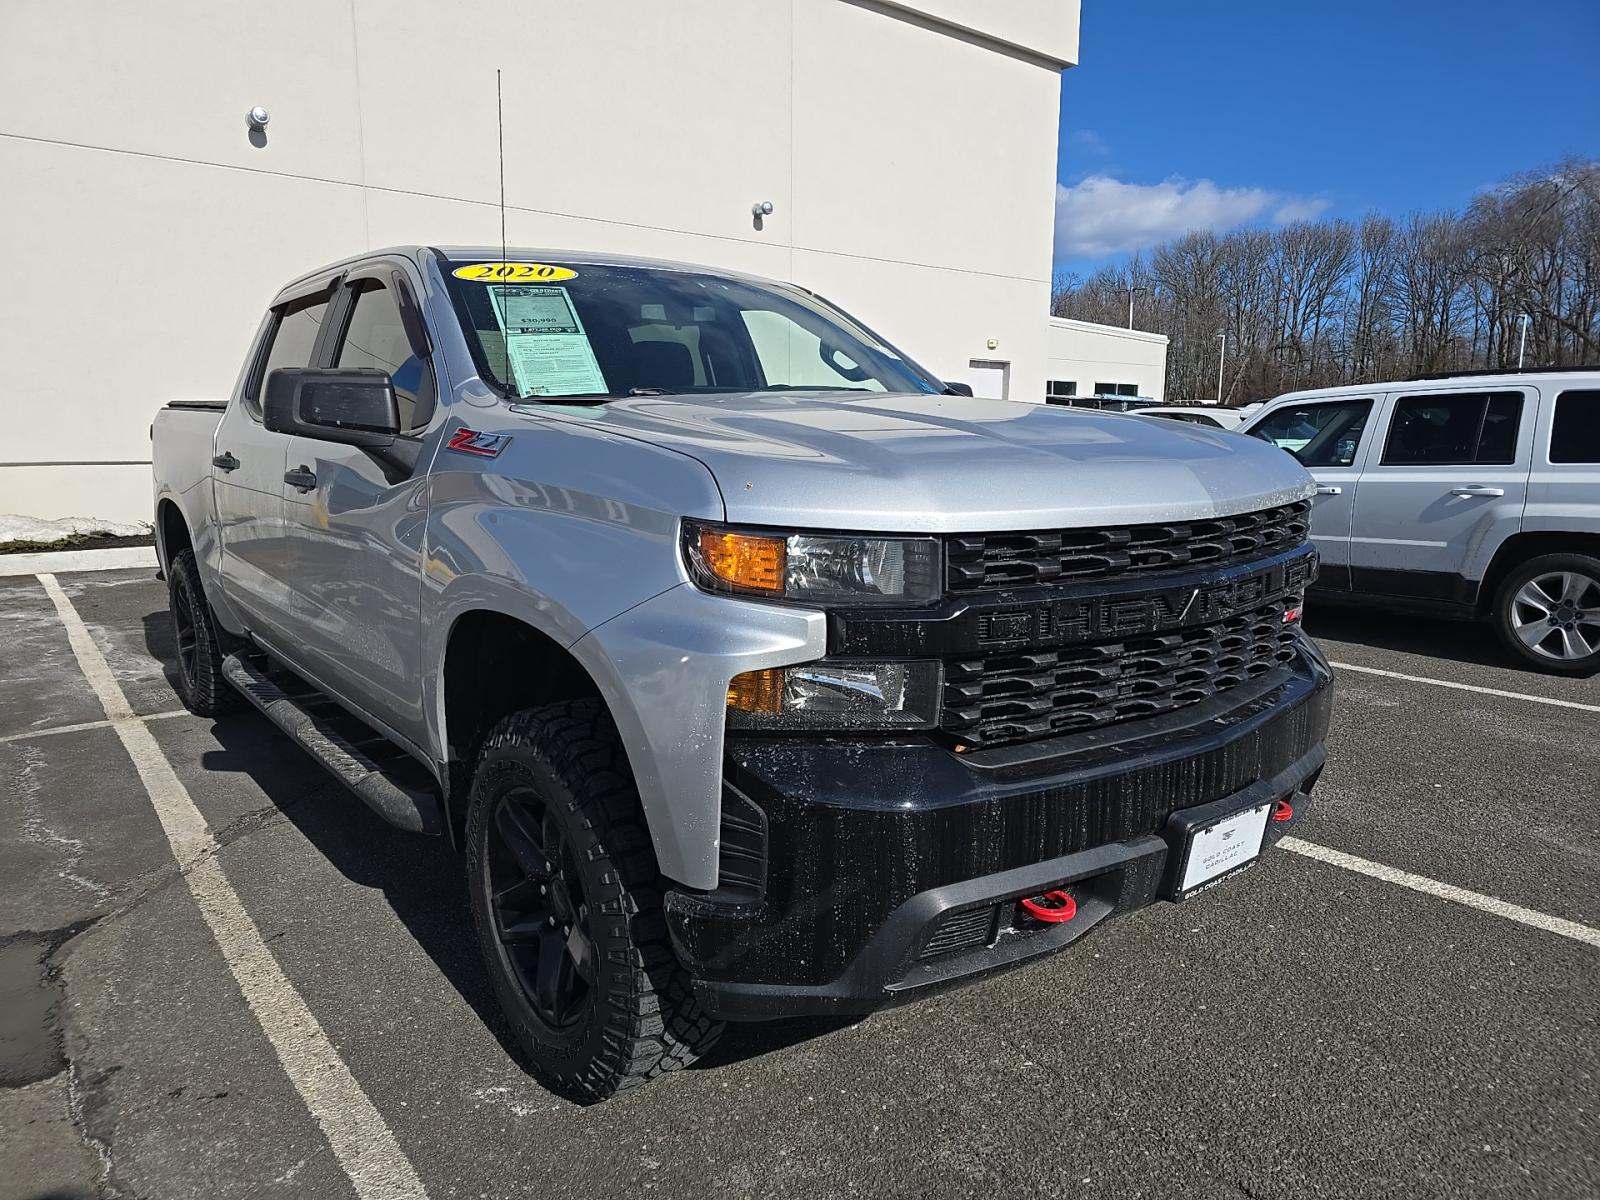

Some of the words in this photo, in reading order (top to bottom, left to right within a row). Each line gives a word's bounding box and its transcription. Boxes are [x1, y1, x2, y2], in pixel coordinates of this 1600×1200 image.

[476, 266, 555, 278] 2020
[1203, 852, 1220, 864] GOLD
[1222, 841, 1245, 854] COAST
[1206, 851, 1238, 869] CADILLAC
[1184, 887, 1204, 900] GOLD
[1204, 876, 1226, 889] COAST
[1227, 861, 1256, 879] CADILLAC
